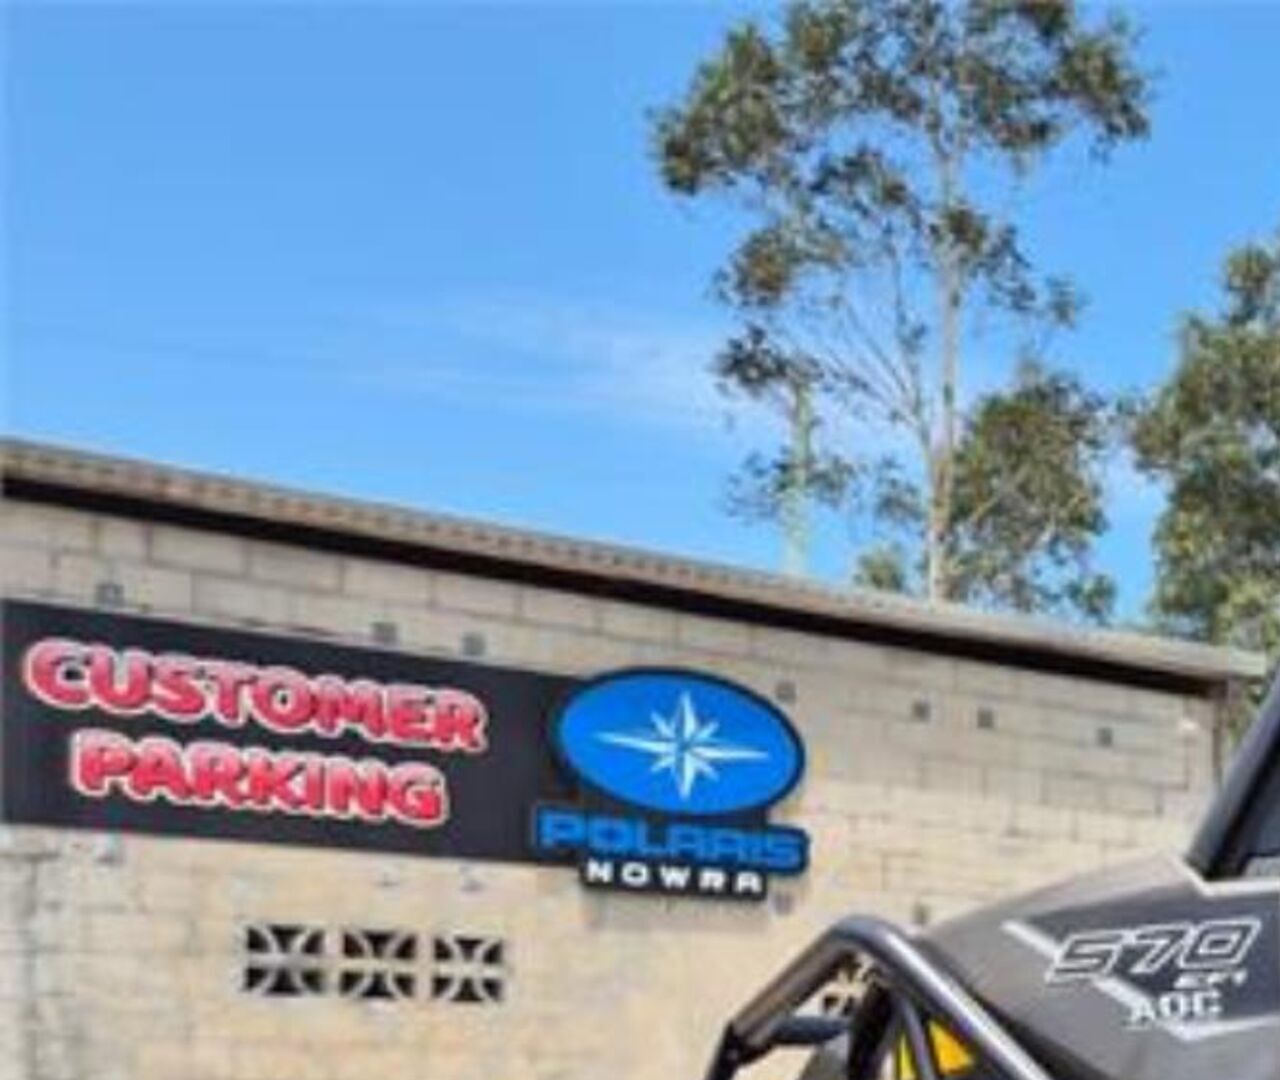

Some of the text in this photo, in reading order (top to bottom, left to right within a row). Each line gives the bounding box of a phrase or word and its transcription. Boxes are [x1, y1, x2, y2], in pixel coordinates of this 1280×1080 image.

[24, 639, 487, 752] CUSTOMER
[72, 729, 447, 828] PARKING
[537, 808, 804, 870] POLARIS
[586, 859, 764, 892] NOWRA
[1046, 916, 1262, 982] 570
